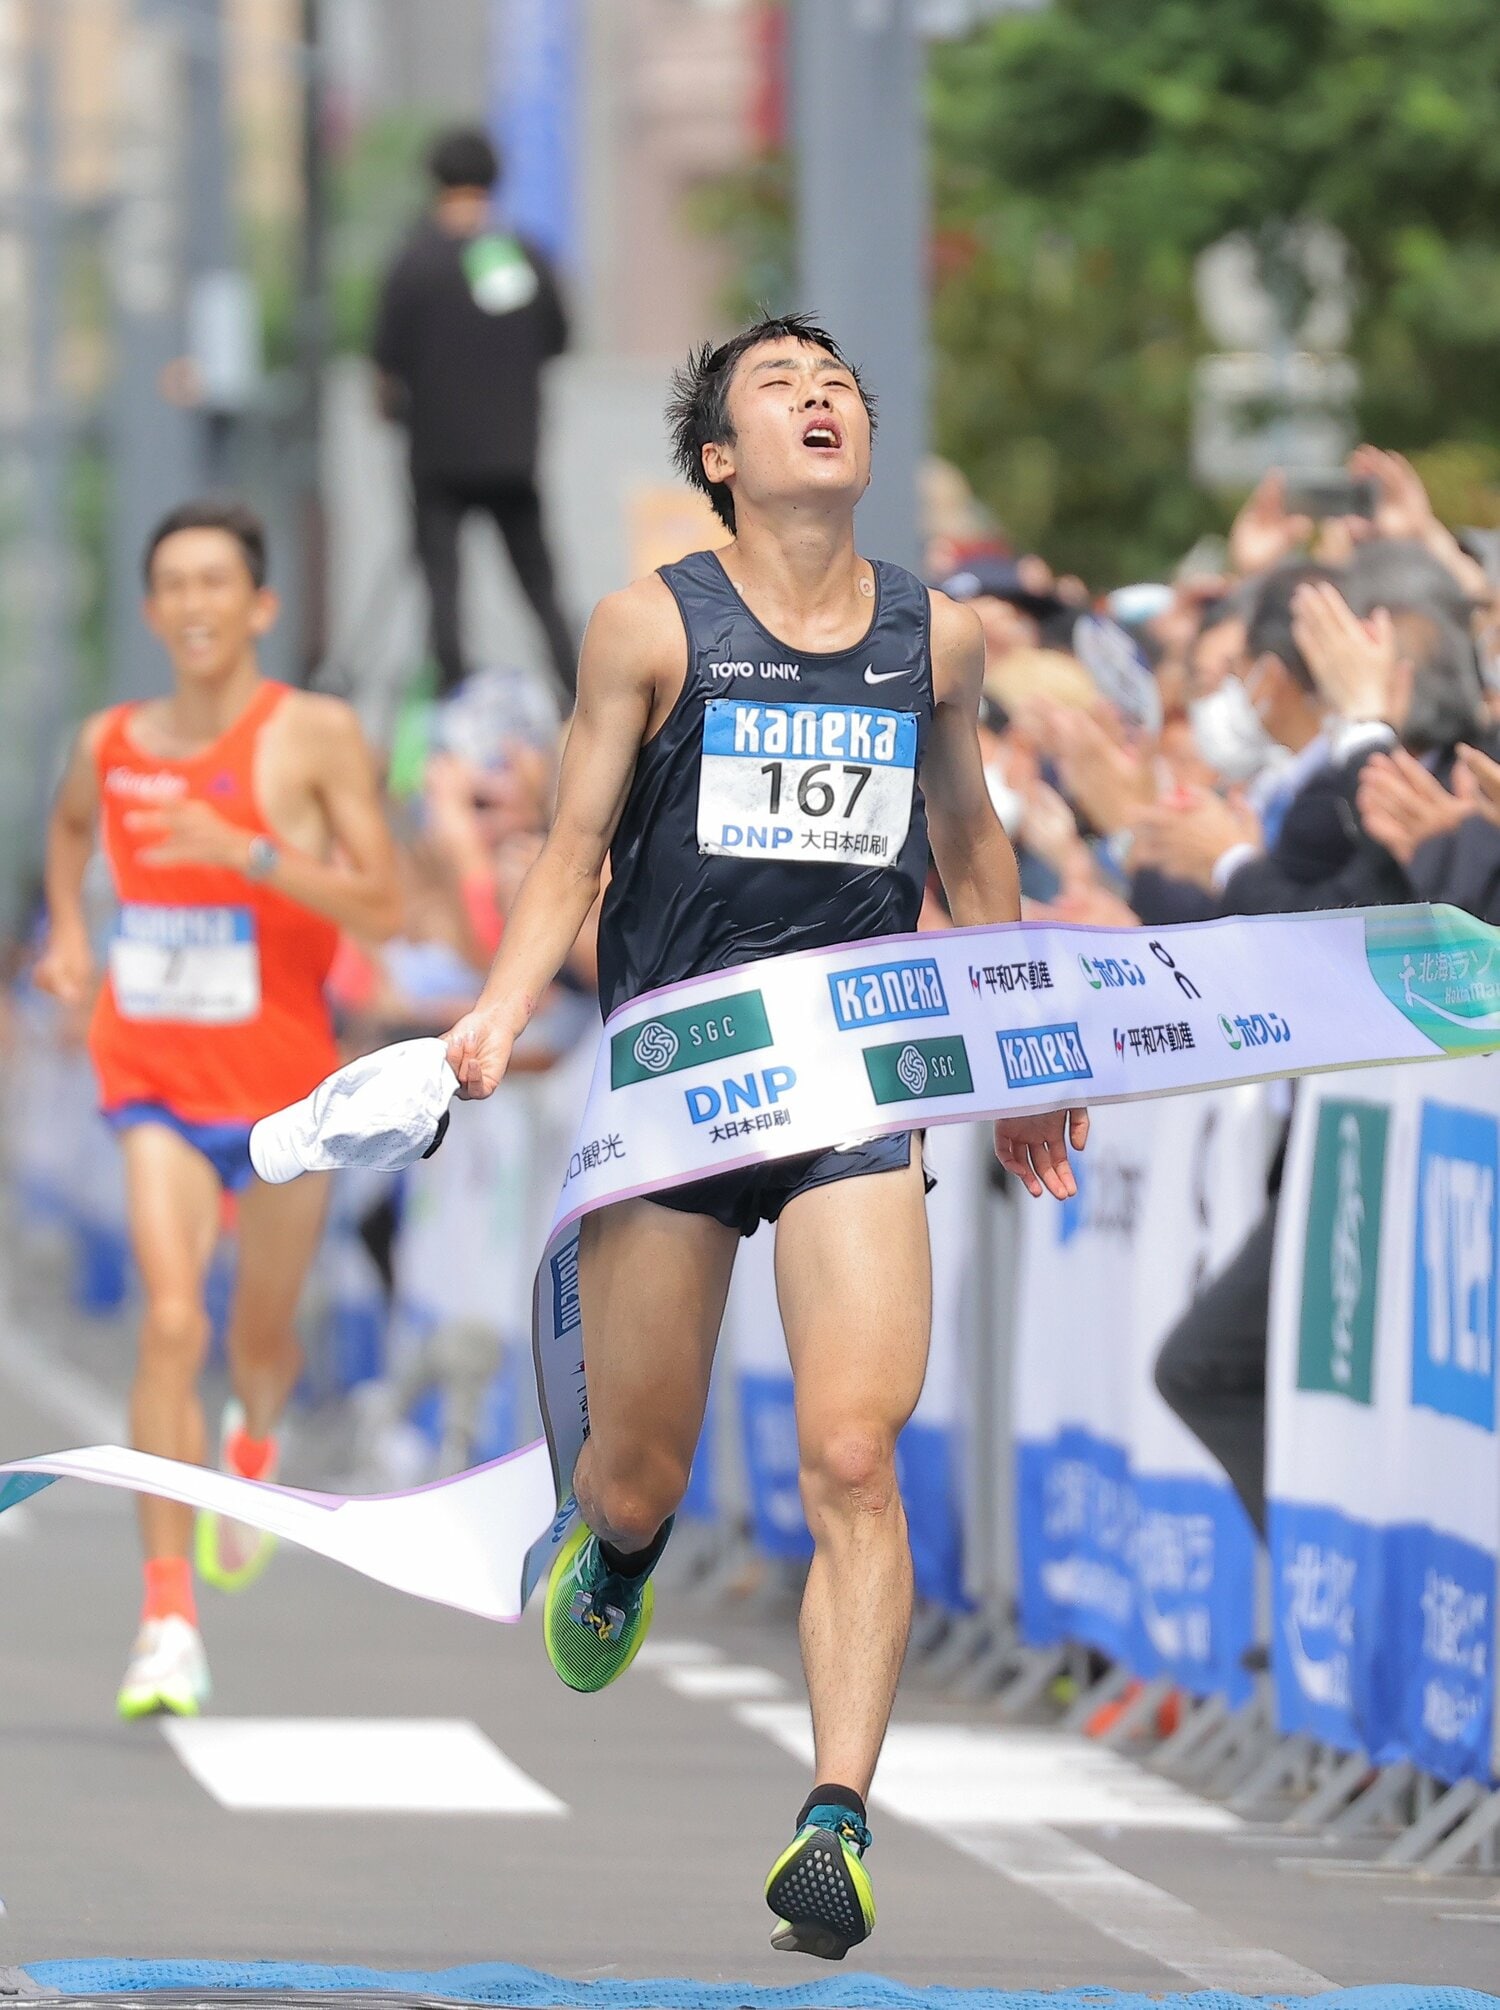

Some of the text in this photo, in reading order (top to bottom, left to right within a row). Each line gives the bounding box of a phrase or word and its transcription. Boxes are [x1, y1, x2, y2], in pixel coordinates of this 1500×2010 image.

[709, 663, 800, 680] TOYO UNIV.
[761, 762, 872, 818] 167
[721, 824, 888, 857] DNP 大日本印刷
[982, 960, 1054, 995] 平和不動産
[1092, 957, 1146, 987] ホクレン
[689, 1016, 736, 1046] SGC
[1127, 1021, 1196, 1057] 平和不動産
[1233, 1013, 1291, 1047] ホクレン
[931, 1055, 955, 1078] SGC
[684, 1065, 797, 1125] DNP
[708, 1108, 792, 1144] 大日本印刷
